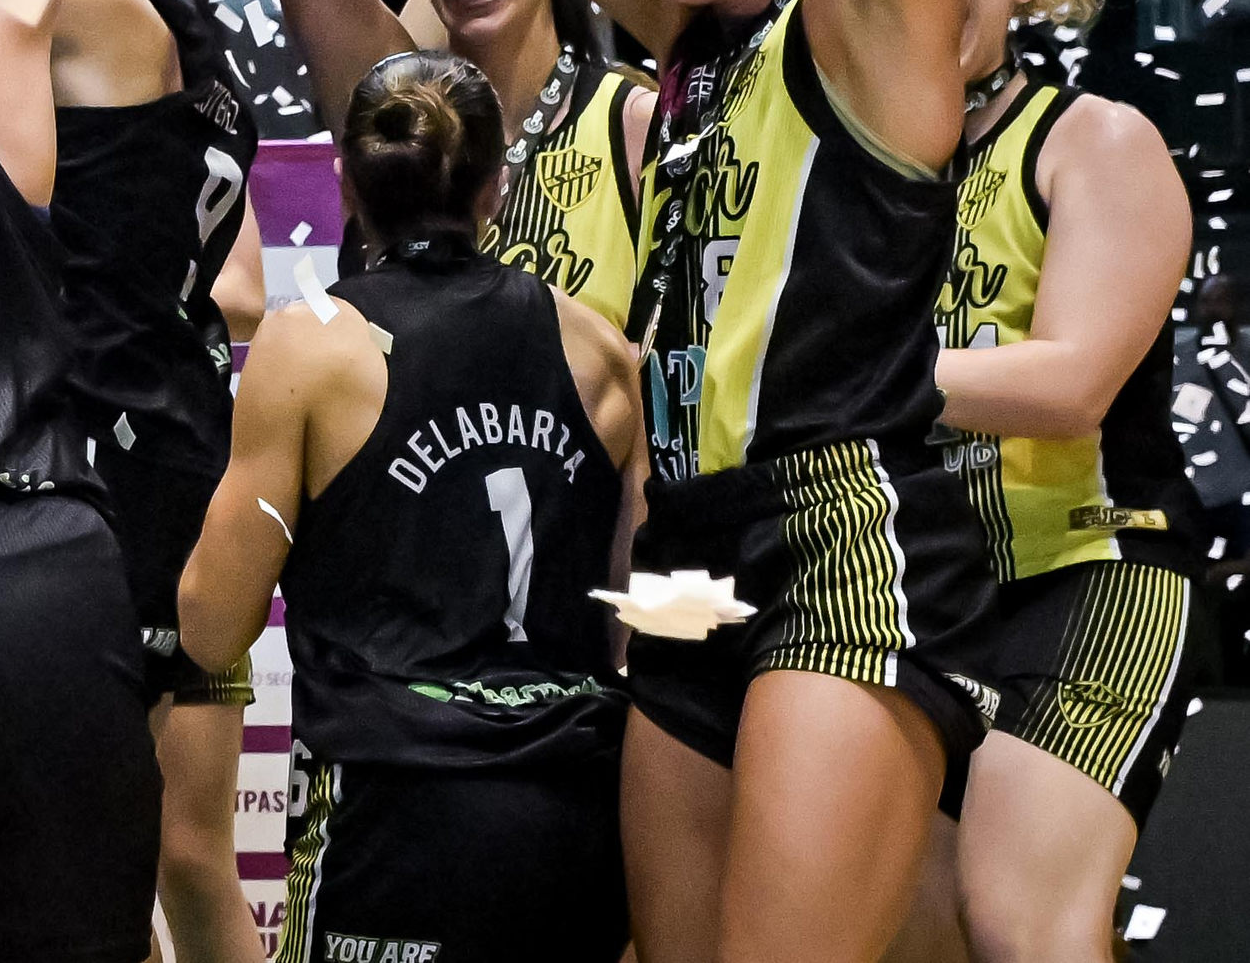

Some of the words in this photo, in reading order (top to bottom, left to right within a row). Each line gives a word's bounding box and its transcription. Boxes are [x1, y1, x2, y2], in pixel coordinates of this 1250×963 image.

[485, 467, 535, 643] 1
[287, 739, 313, 817] 6
[325, 934, 377, 963] YOU
[379, 938, 439, 963] ARE
